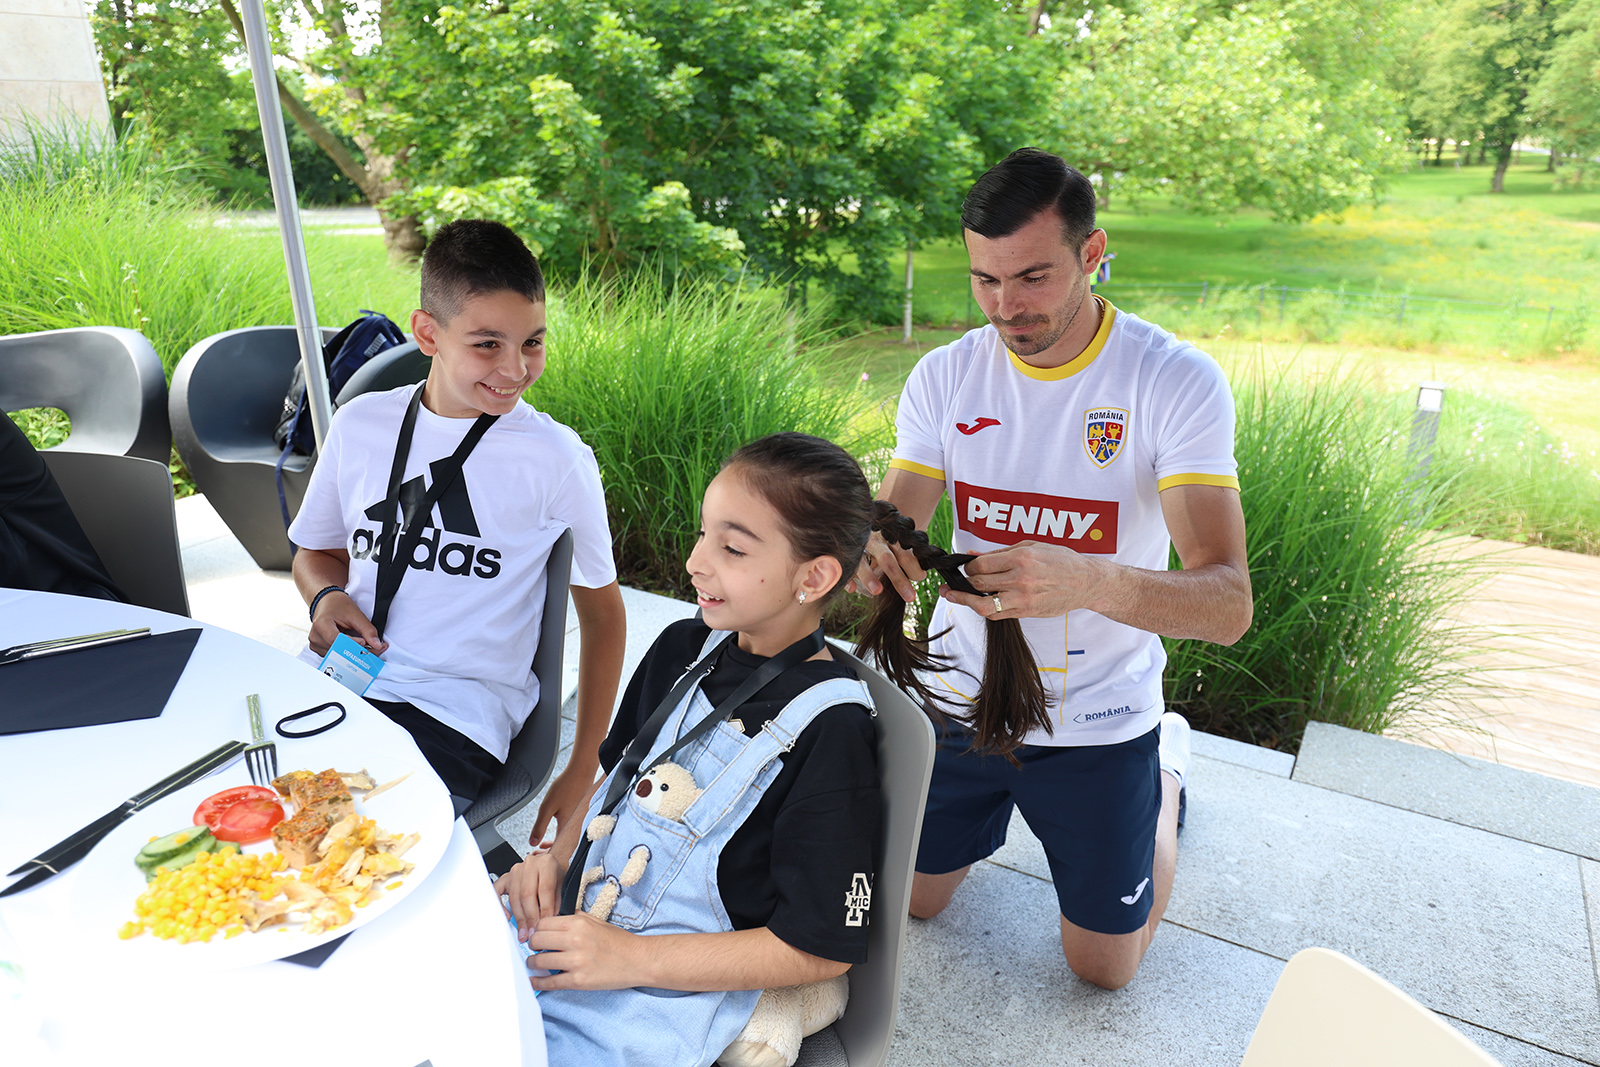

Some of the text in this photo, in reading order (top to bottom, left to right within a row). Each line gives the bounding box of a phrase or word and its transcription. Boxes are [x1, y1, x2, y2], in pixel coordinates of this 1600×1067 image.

[1089, 410, 1124, 421] ROMÂNIA
[352, 523, 502, 579] adas
[1085, 705, 1131, 721] ROMÂNIA
